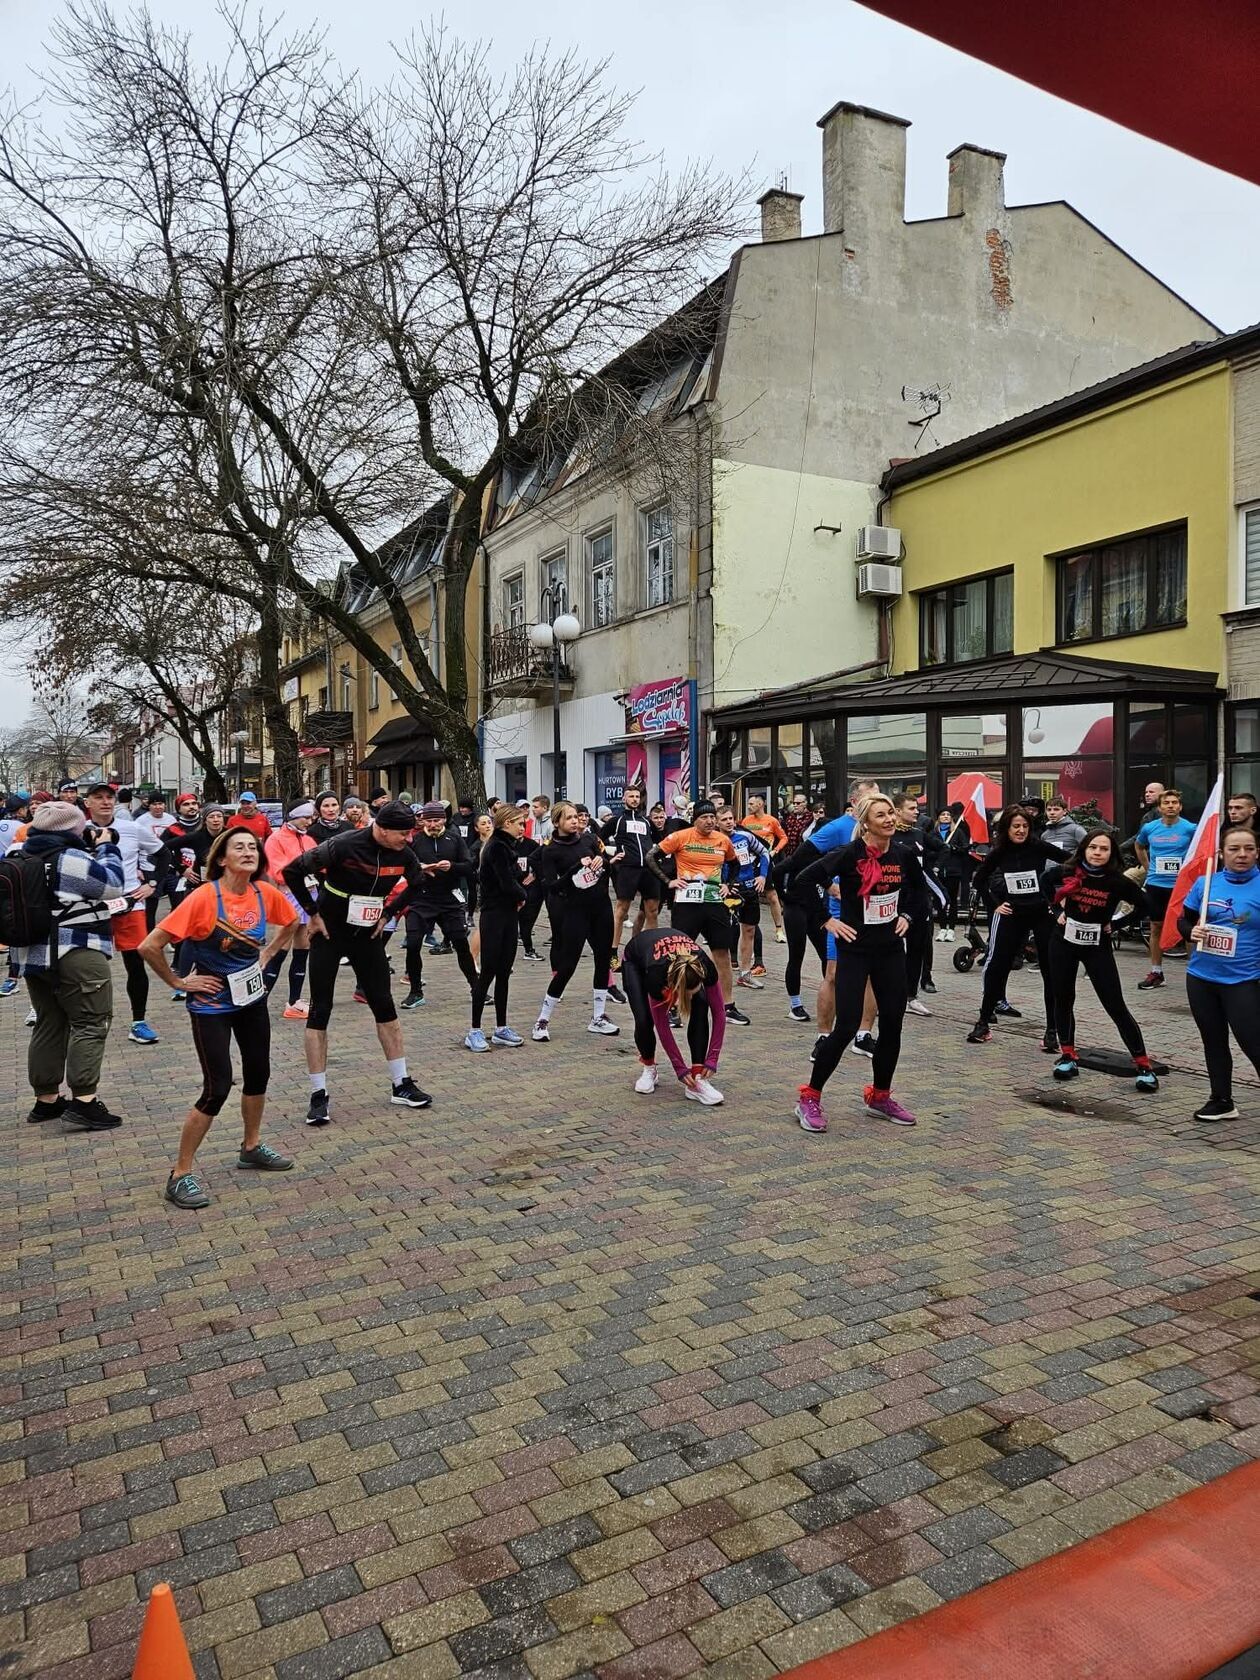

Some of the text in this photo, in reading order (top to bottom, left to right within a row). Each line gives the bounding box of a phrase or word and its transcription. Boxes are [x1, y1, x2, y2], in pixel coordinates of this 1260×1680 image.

[632, 682, 684, 716] Lodziarnia
[606, 787, 623, 799] RYB
[1019, 879, 1032, 888] 159
[1079, 931, 1094, 941] 148
[1210, 936, 1229, 950] 080
[249, 975, 261, 993] 150
